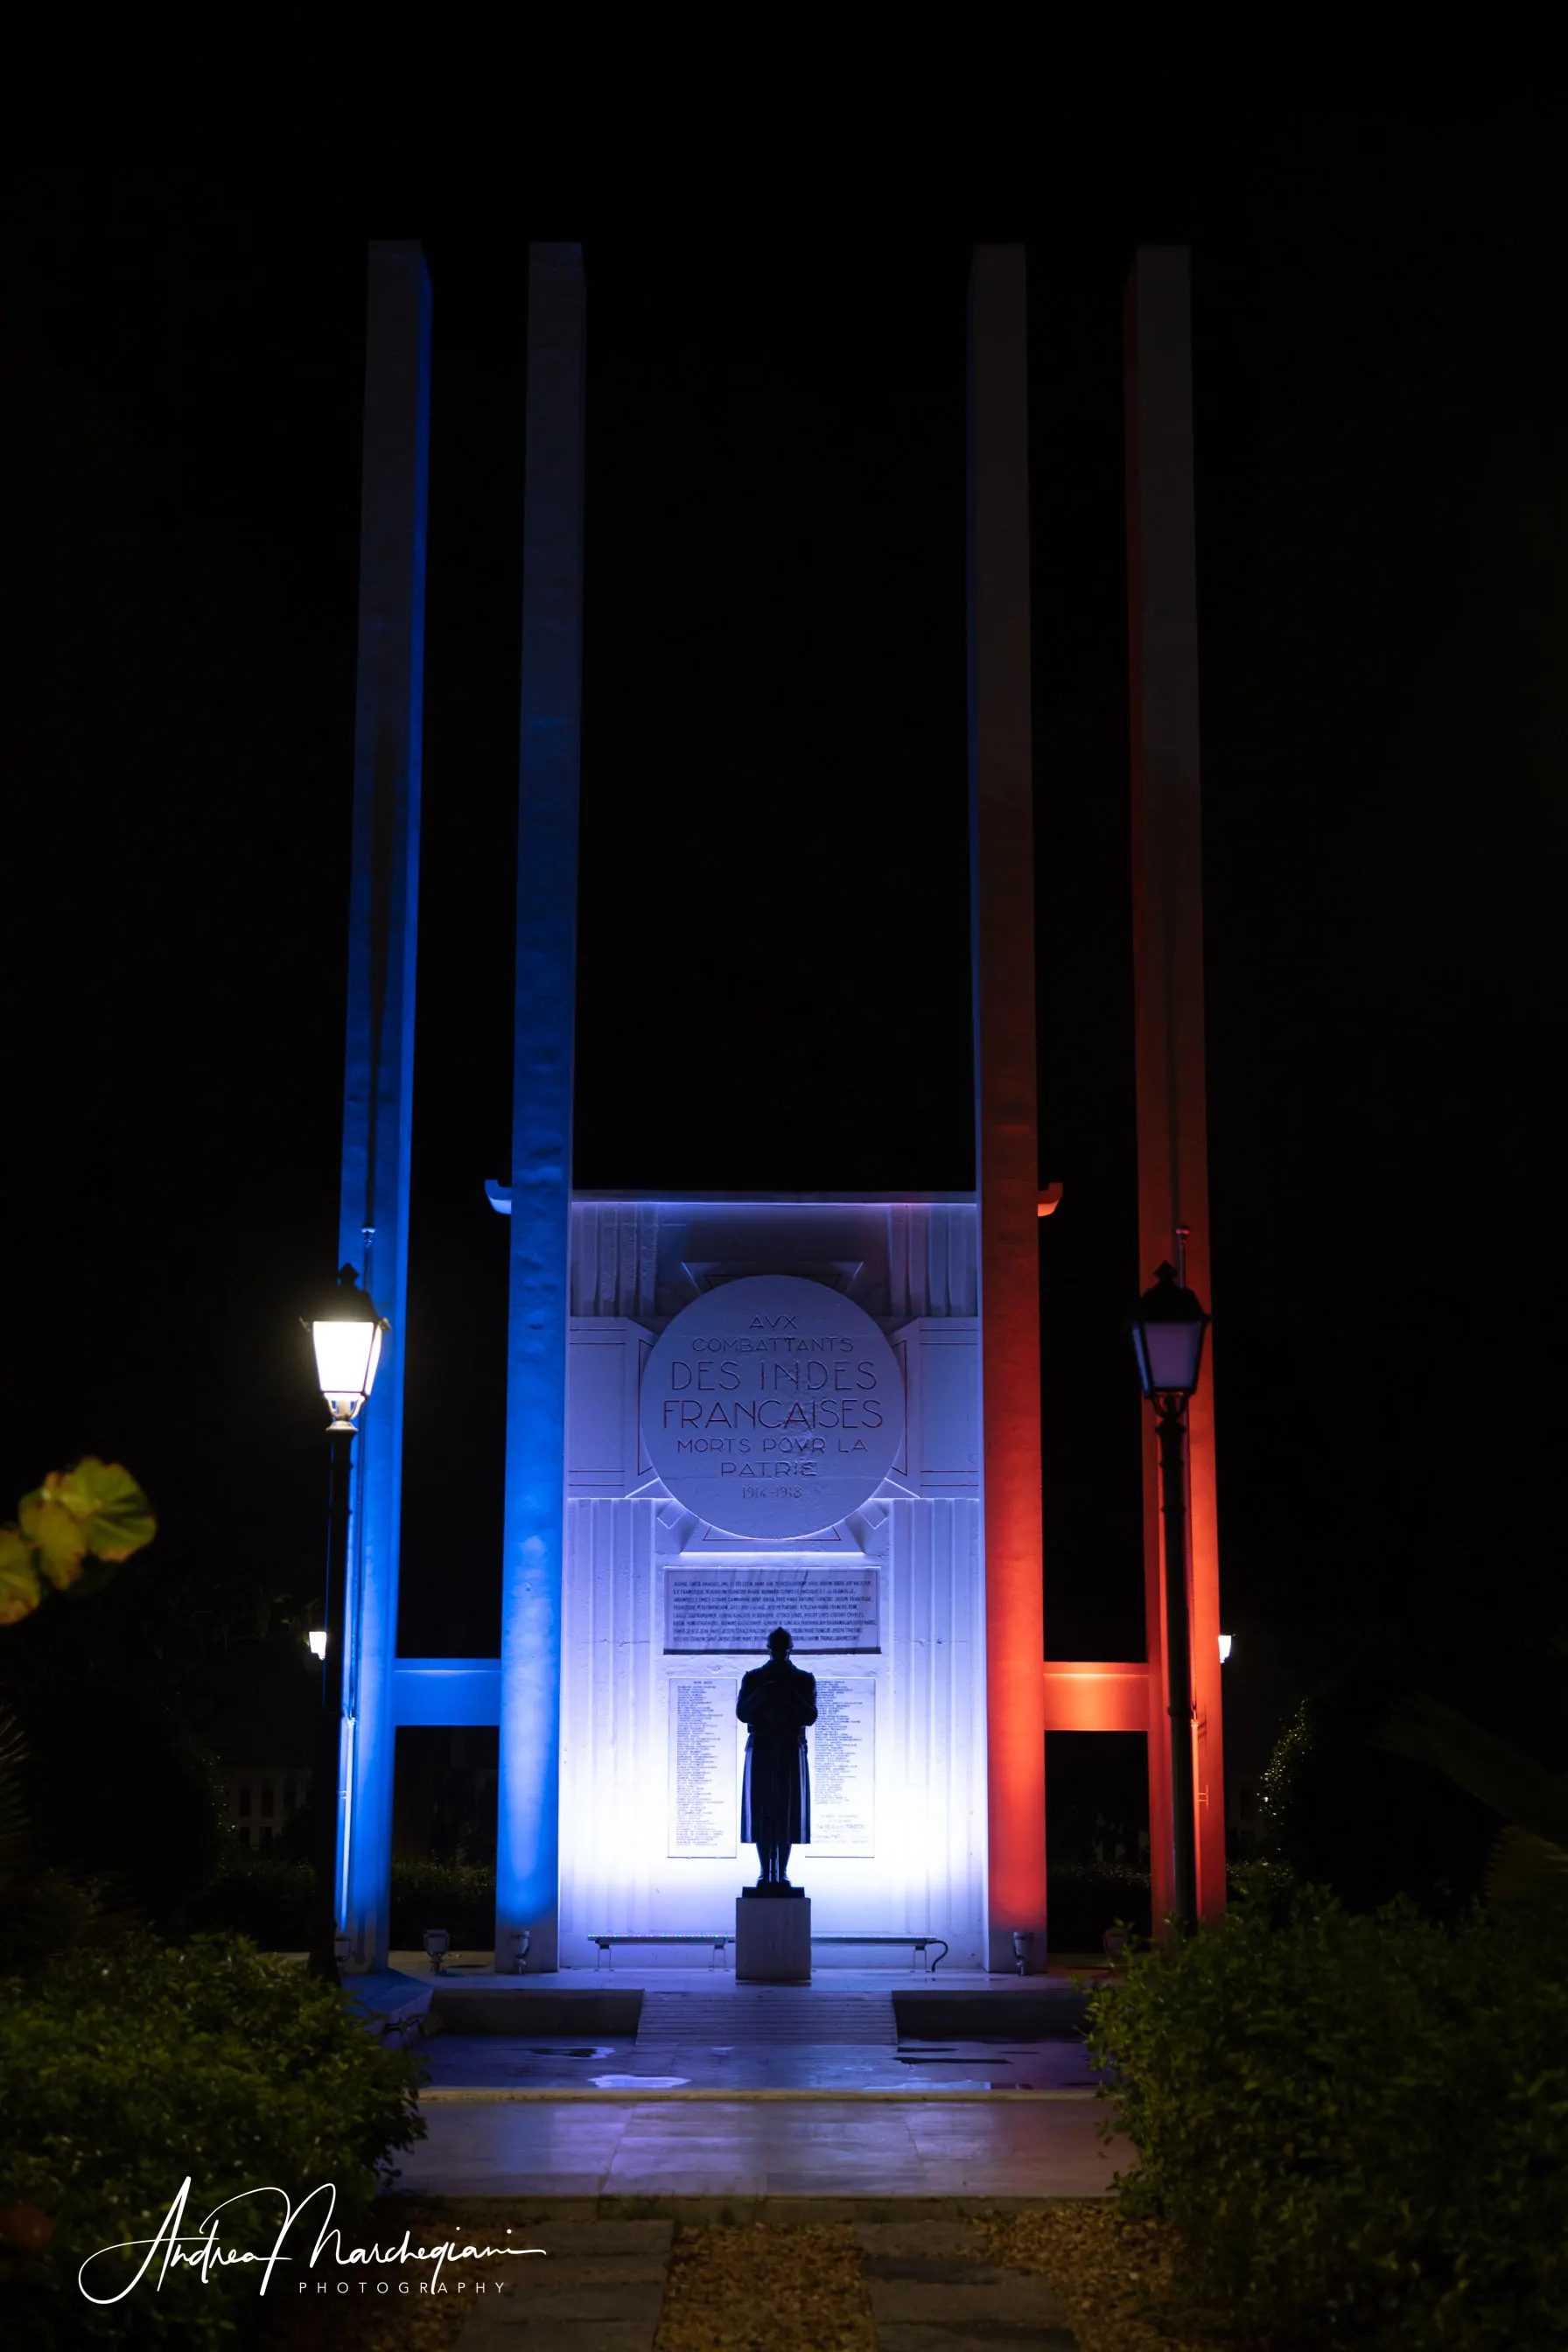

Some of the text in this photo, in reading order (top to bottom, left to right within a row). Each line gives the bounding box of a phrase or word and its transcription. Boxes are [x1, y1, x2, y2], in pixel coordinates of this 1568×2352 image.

[692, 1337, 854, 1353] COMBATTANTS
[671, 1361, 878, 1390] DES INDES
[677, 1438, 751, 1453] MORTS
[837, 1438, 868, 1453] LA
[721, 1461, 817, 1477] PATRIE
